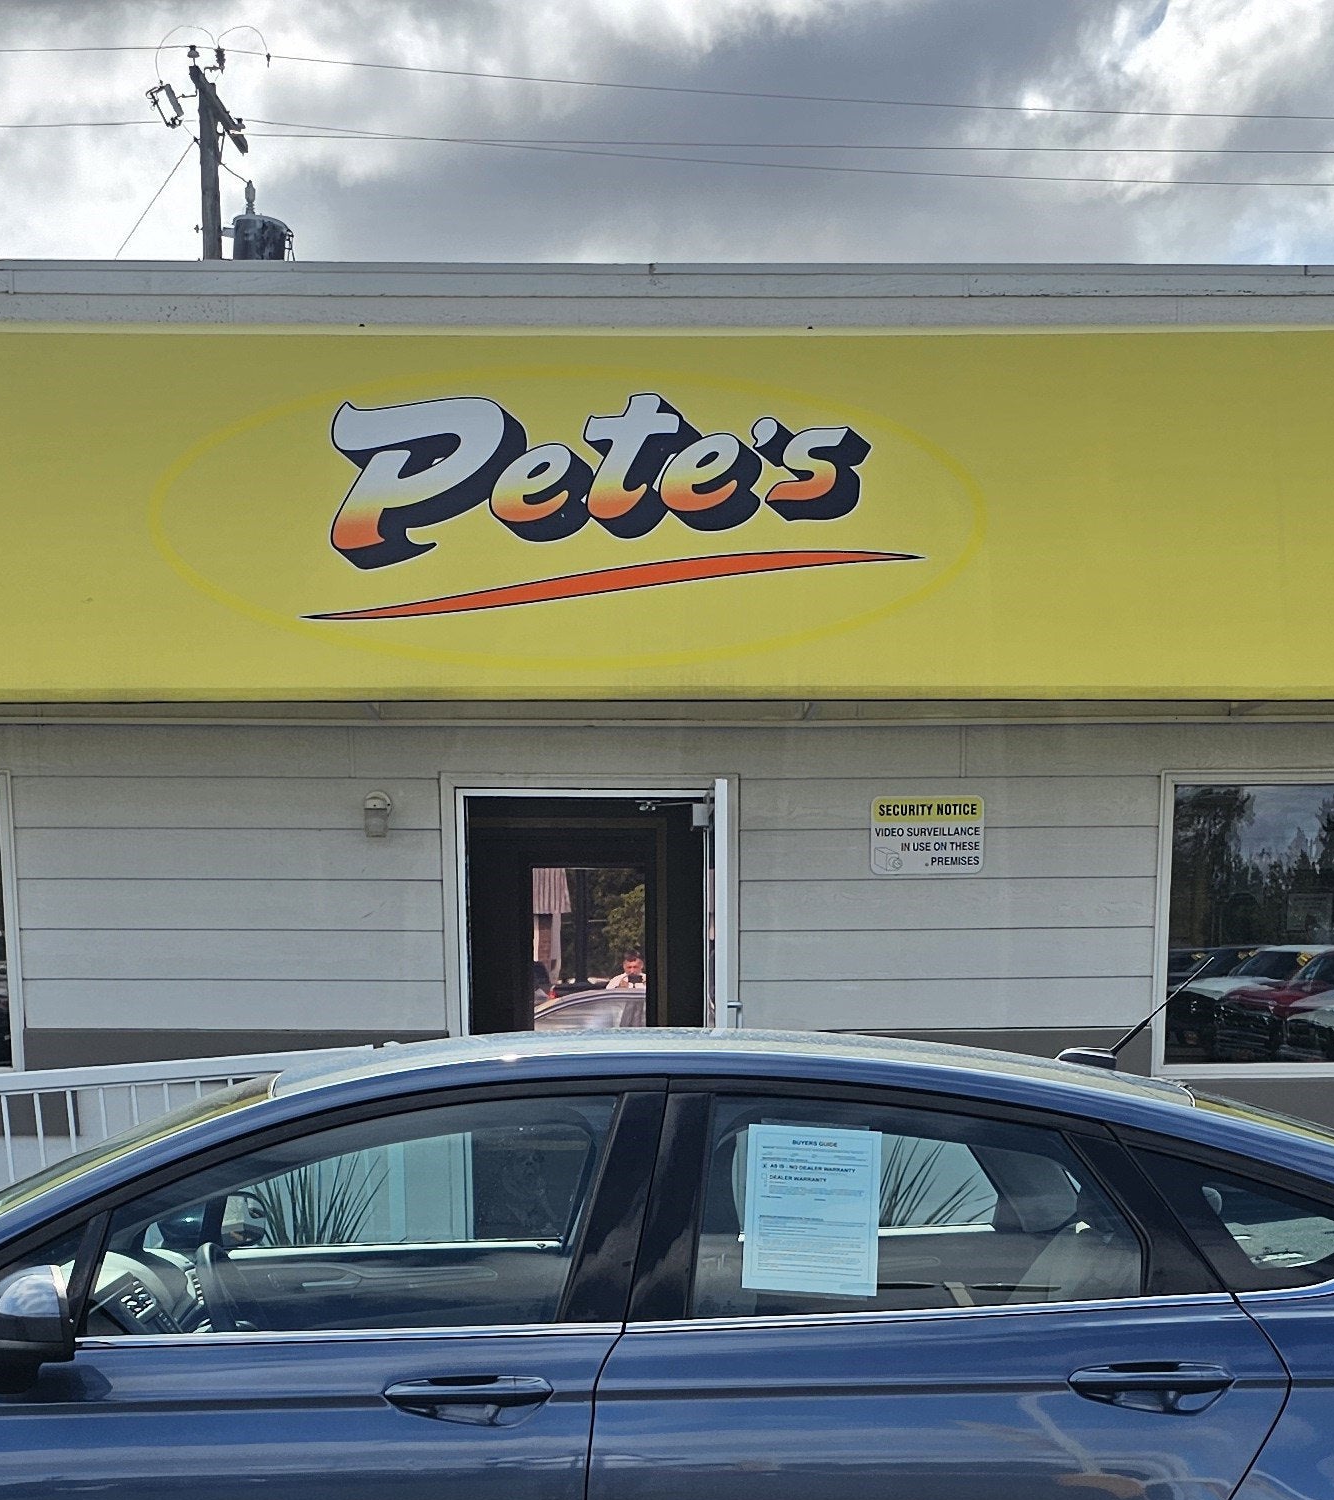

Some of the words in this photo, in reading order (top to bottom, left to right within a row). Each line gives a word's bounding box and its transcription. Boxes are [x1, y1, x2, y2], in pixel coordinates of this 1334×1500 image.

[330, 392, 871, 570] Pete's
[878, 804, 933, 816] SECURITY
[936, 803, 977, 815] NOTICE
[875, 827, 904, 837] VIDEO
[907, 826, 980, 836] SURVEILLANCE
[901, 843, 910, 851] IN
[912, 842, 931, 851] USE
[933, 842, 947, 851] ON
[949, 841, 980, 851] THESE
[930, 856, 980, 866] PREMISES
